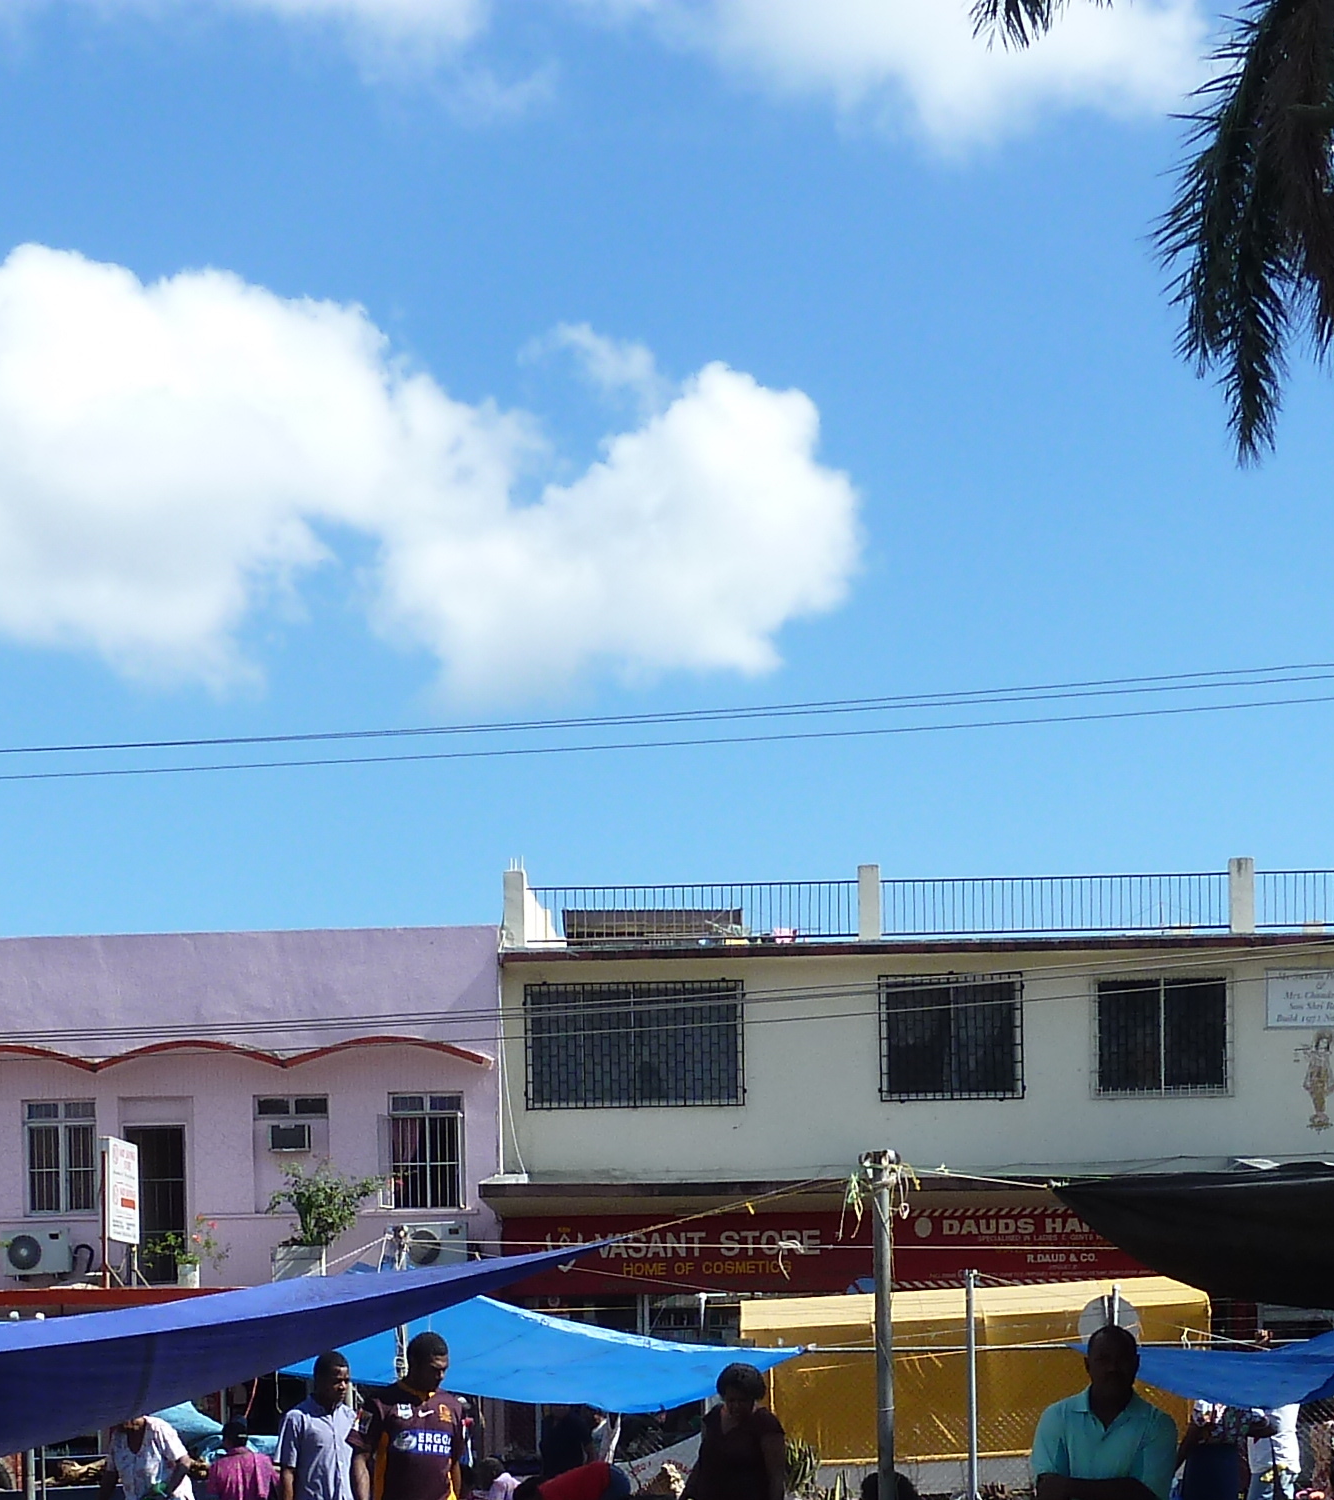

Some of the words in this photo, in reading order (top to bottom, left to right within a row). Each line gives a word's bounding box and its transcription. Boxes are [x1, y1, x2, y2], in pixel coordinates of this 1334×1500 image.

[942, 1218, 1036, 1235] DAUDS
[595, 1231, 706, 1259] VASANT
[720, 1229, 821, 1258] STORE
[1069, 1253, 1078, 1262] &
[1080, 1253, 1098, 1262] CO.
[623, 1262, 667, 1276] HOME
[674, 1261, 695, 1274] OF
[702, 1260, 792, 1274] COSMETICS
